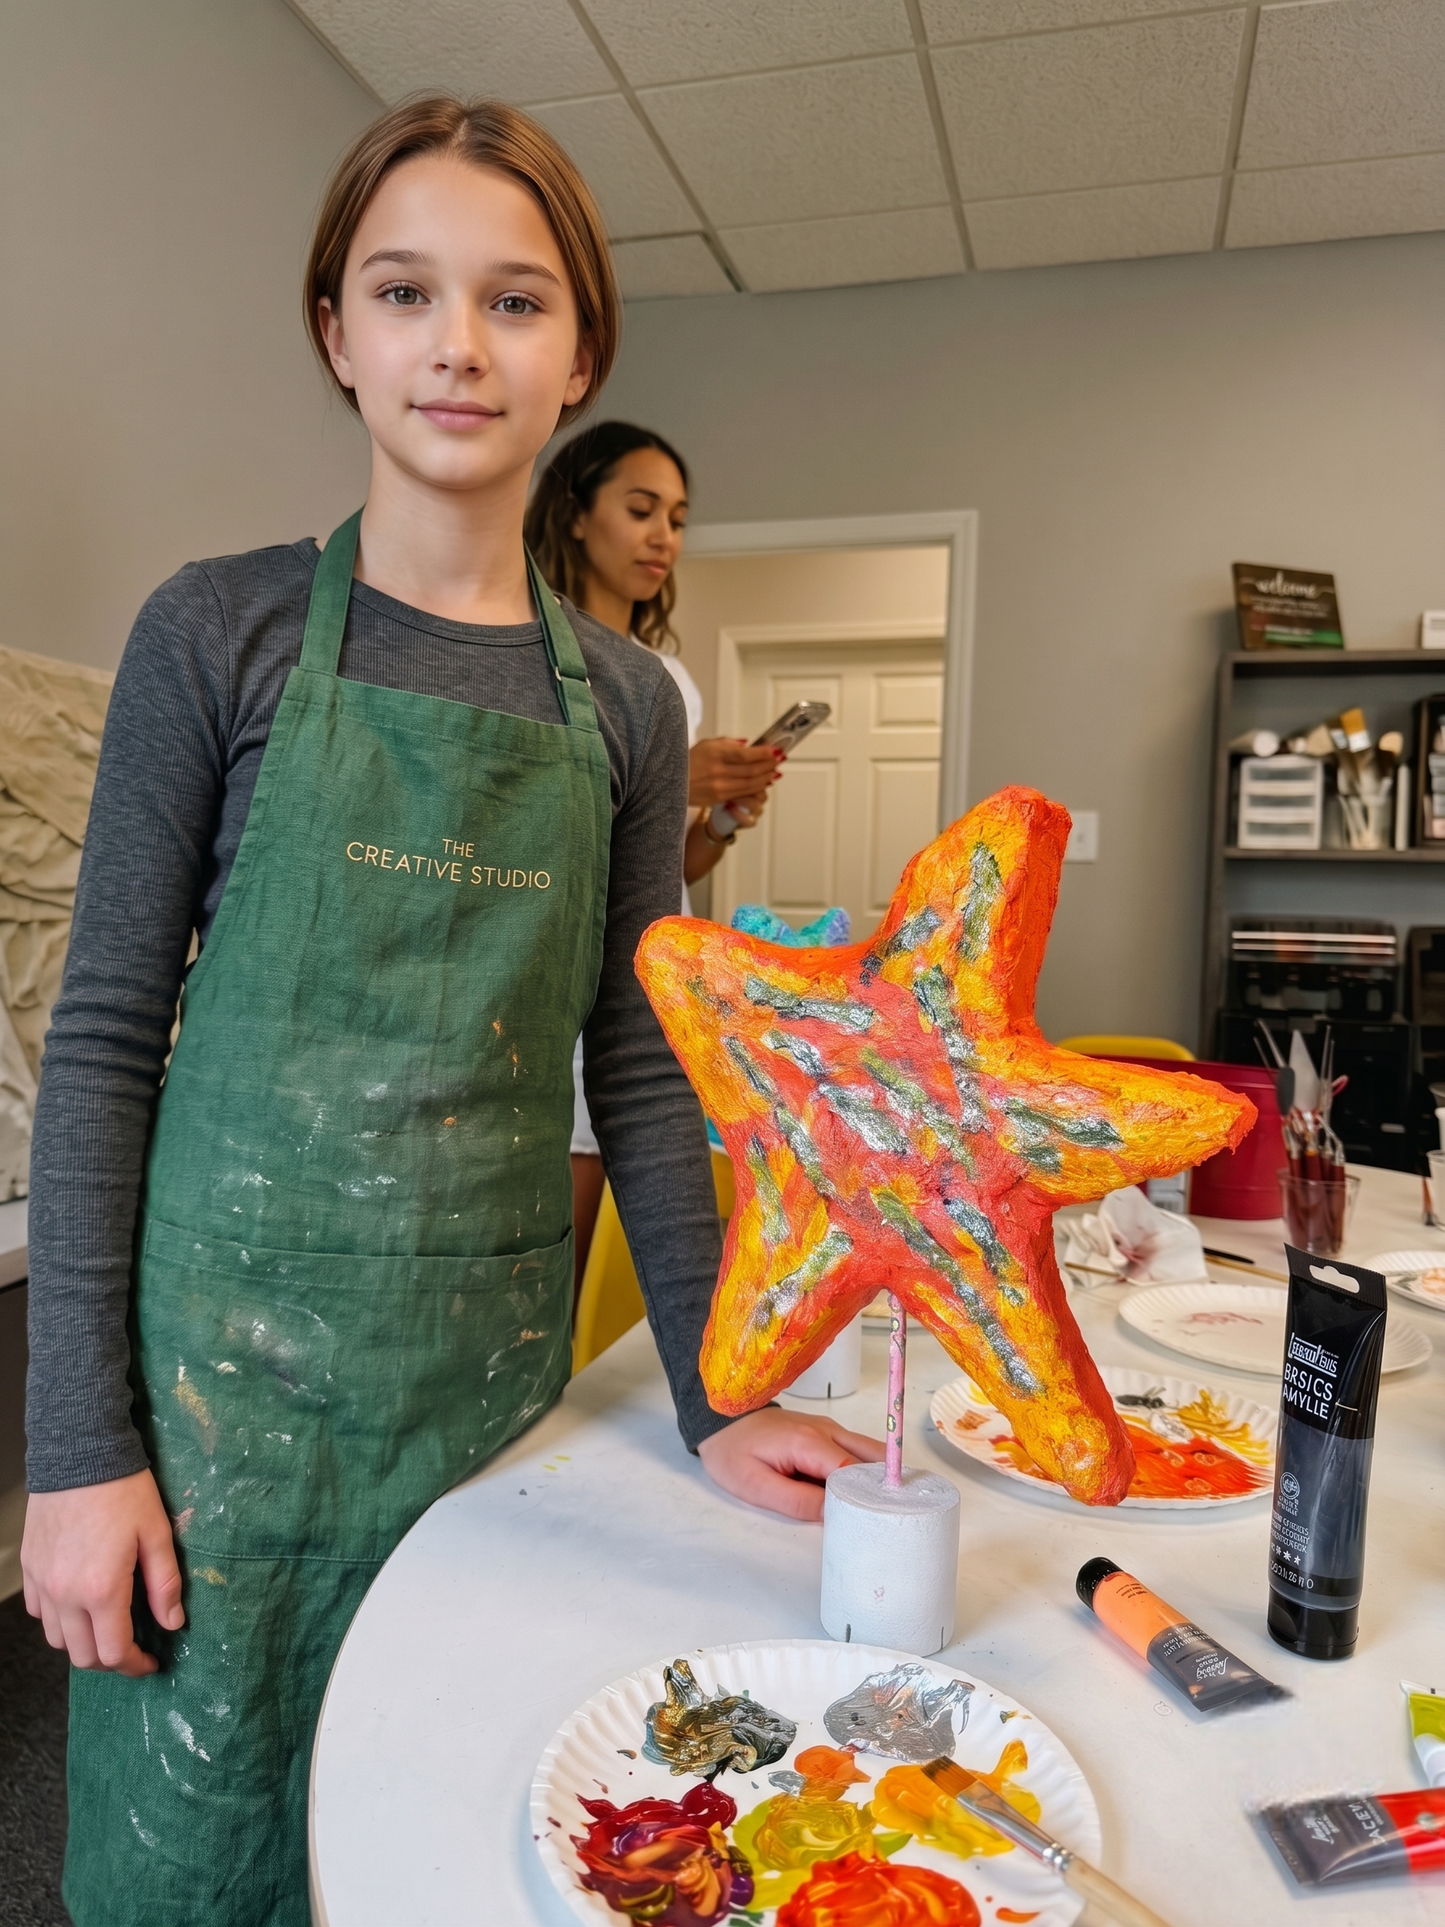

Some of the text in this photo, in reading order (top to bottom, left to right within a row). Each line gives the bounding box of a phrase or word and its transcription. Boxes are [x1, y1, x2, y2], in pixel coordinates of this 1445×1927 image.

[346, 841, 551, 889] CREATIVE STUDIO
[442, 838, 475, 858] THE
